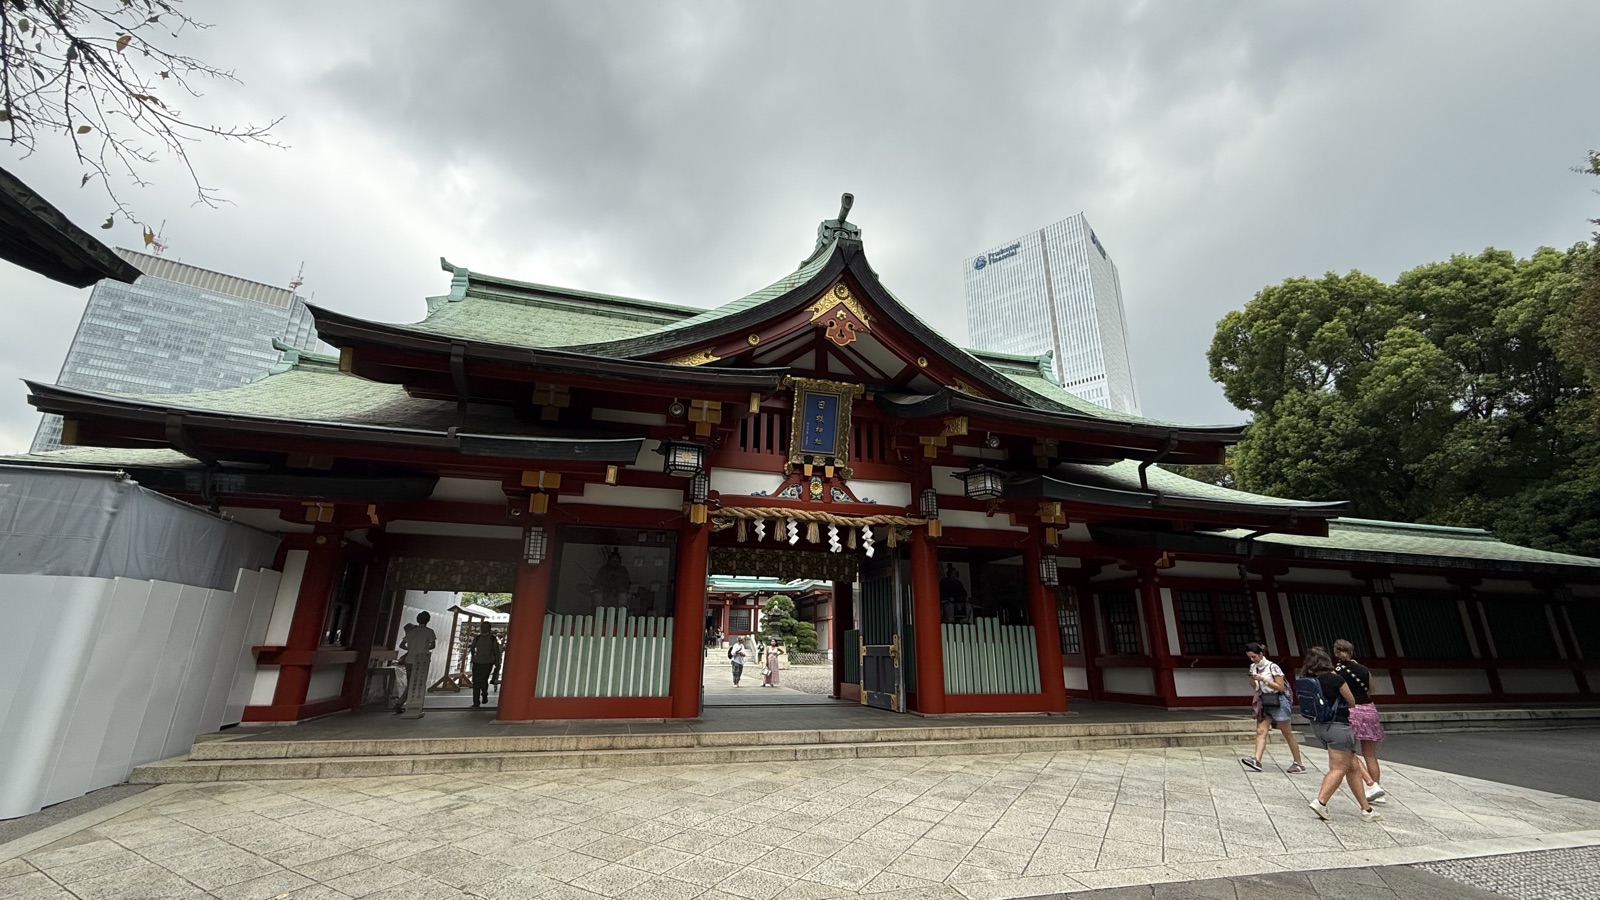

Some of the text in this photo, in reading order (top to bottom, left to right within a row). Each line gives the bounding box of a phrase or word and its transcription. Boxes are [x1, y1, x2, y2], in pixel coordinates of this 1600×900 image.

[988, 241, 1020, 258] Prudential
[988, 247, 1017, 265] Financial
[814, 400, 825, 445] 日枝神社
